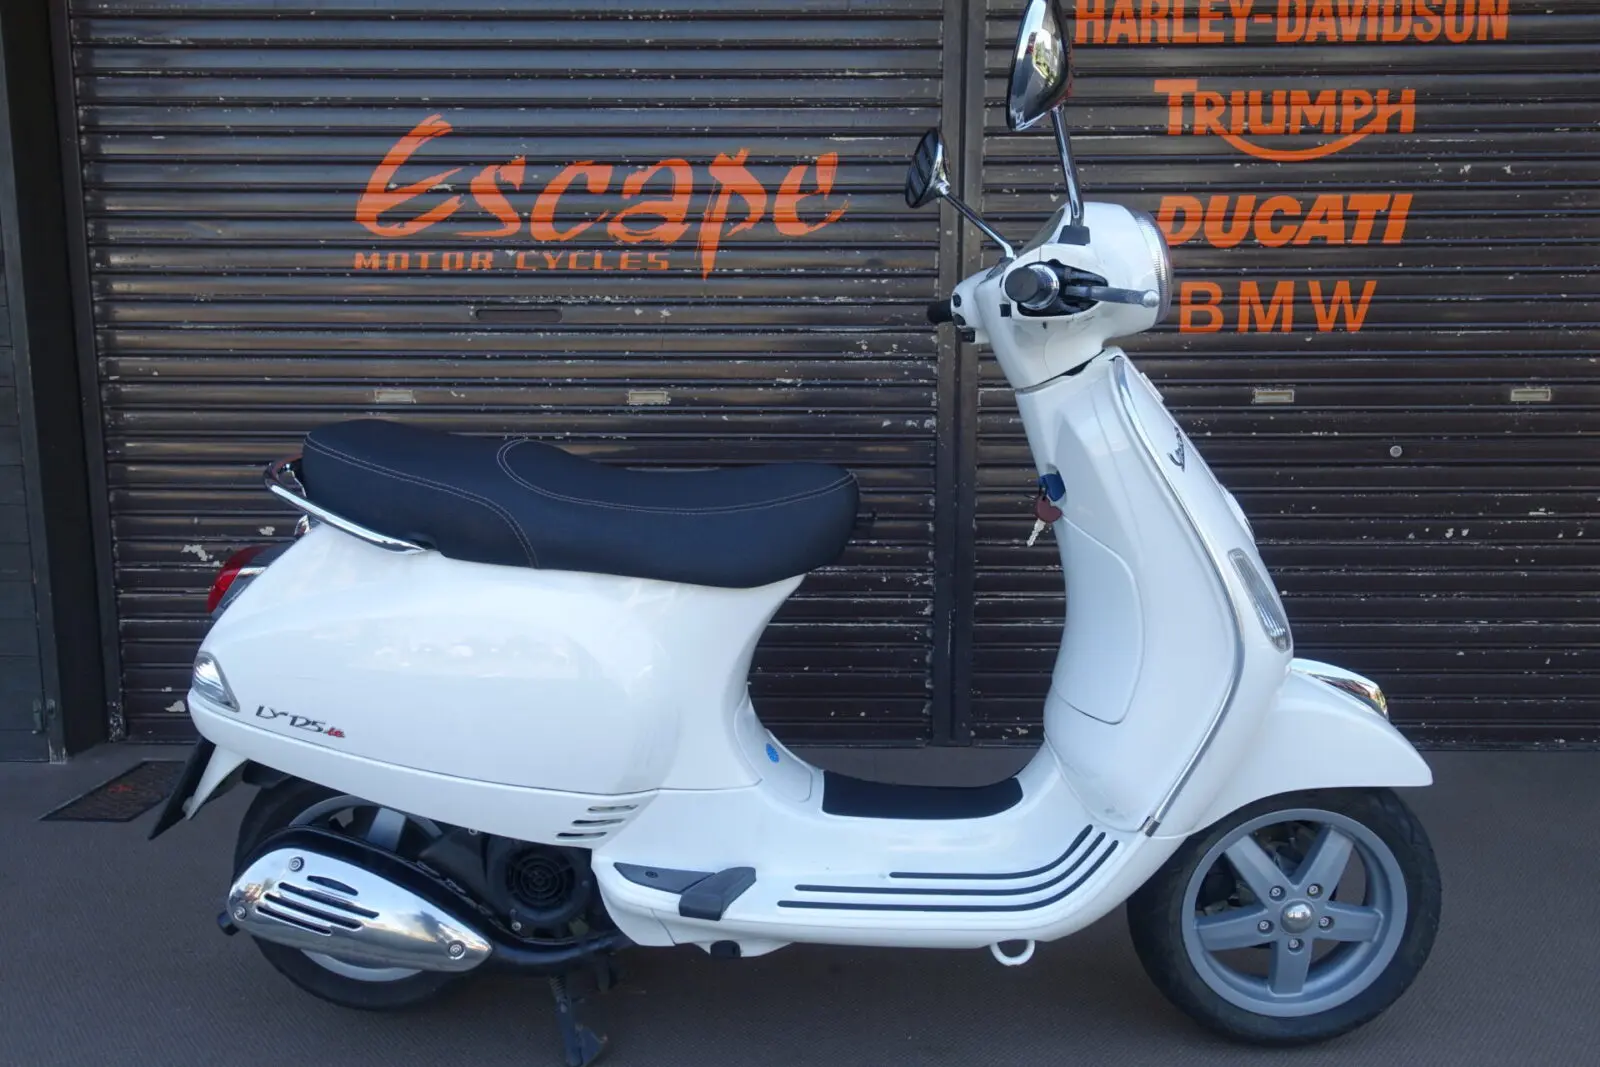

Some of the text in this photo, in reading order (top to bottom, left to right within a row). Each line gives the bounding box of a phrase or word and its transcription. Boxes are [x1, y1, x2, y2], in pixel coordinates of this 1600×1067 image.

[1073, 0, 1510, 45] HARLEY-DAVIDSON
[1153, 78, 1417, 161] TRIUMPH
[353, 115, 849, 280] Escape
[1156, 193, 1414, 248] DUCATI
[353, 252, 671, 271] MOTOR CYCLES
[1178, 279, 1378, 334] BMW
